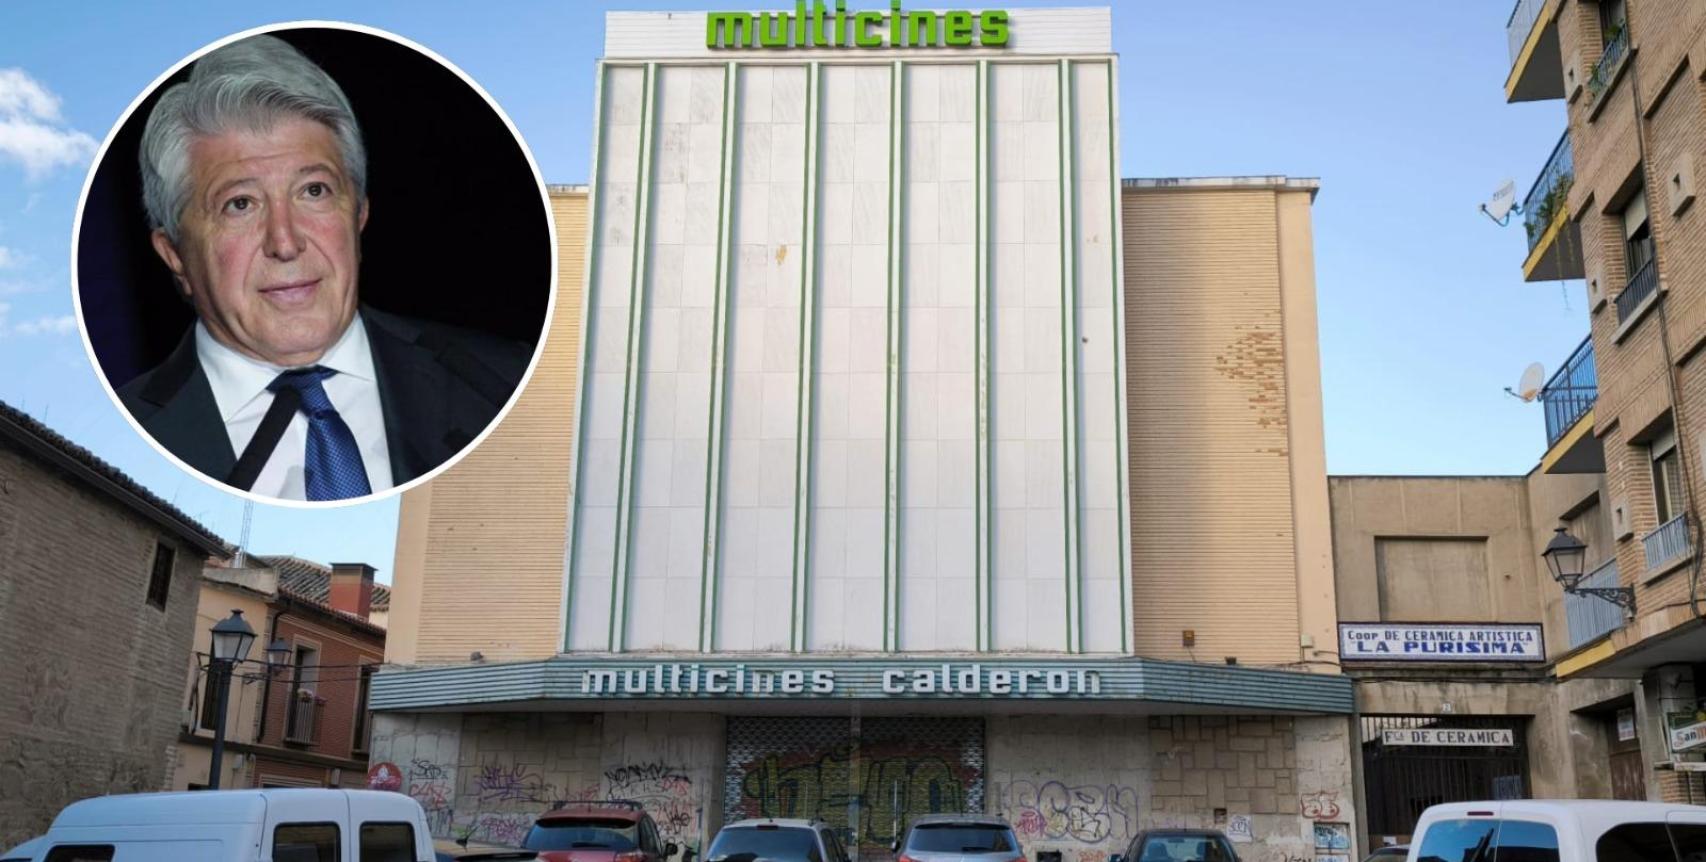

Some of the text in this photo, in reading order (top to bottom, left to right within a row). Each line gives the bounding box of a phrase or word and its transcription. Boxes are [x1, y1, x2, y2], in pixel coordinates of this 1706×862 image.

[706, 0, 1009, 49] multicines
[1384, 630, 1400, 641] DE
[1405, 630, 1464, 642] CERAMICA
[1469, 631, 1533, 642] ARTISTICA
[581, 664, 1101, 694] multicines calderon
[1411, 731, 1431, 743] DE
[1436, 731, 1510, 744] CERAMICA
